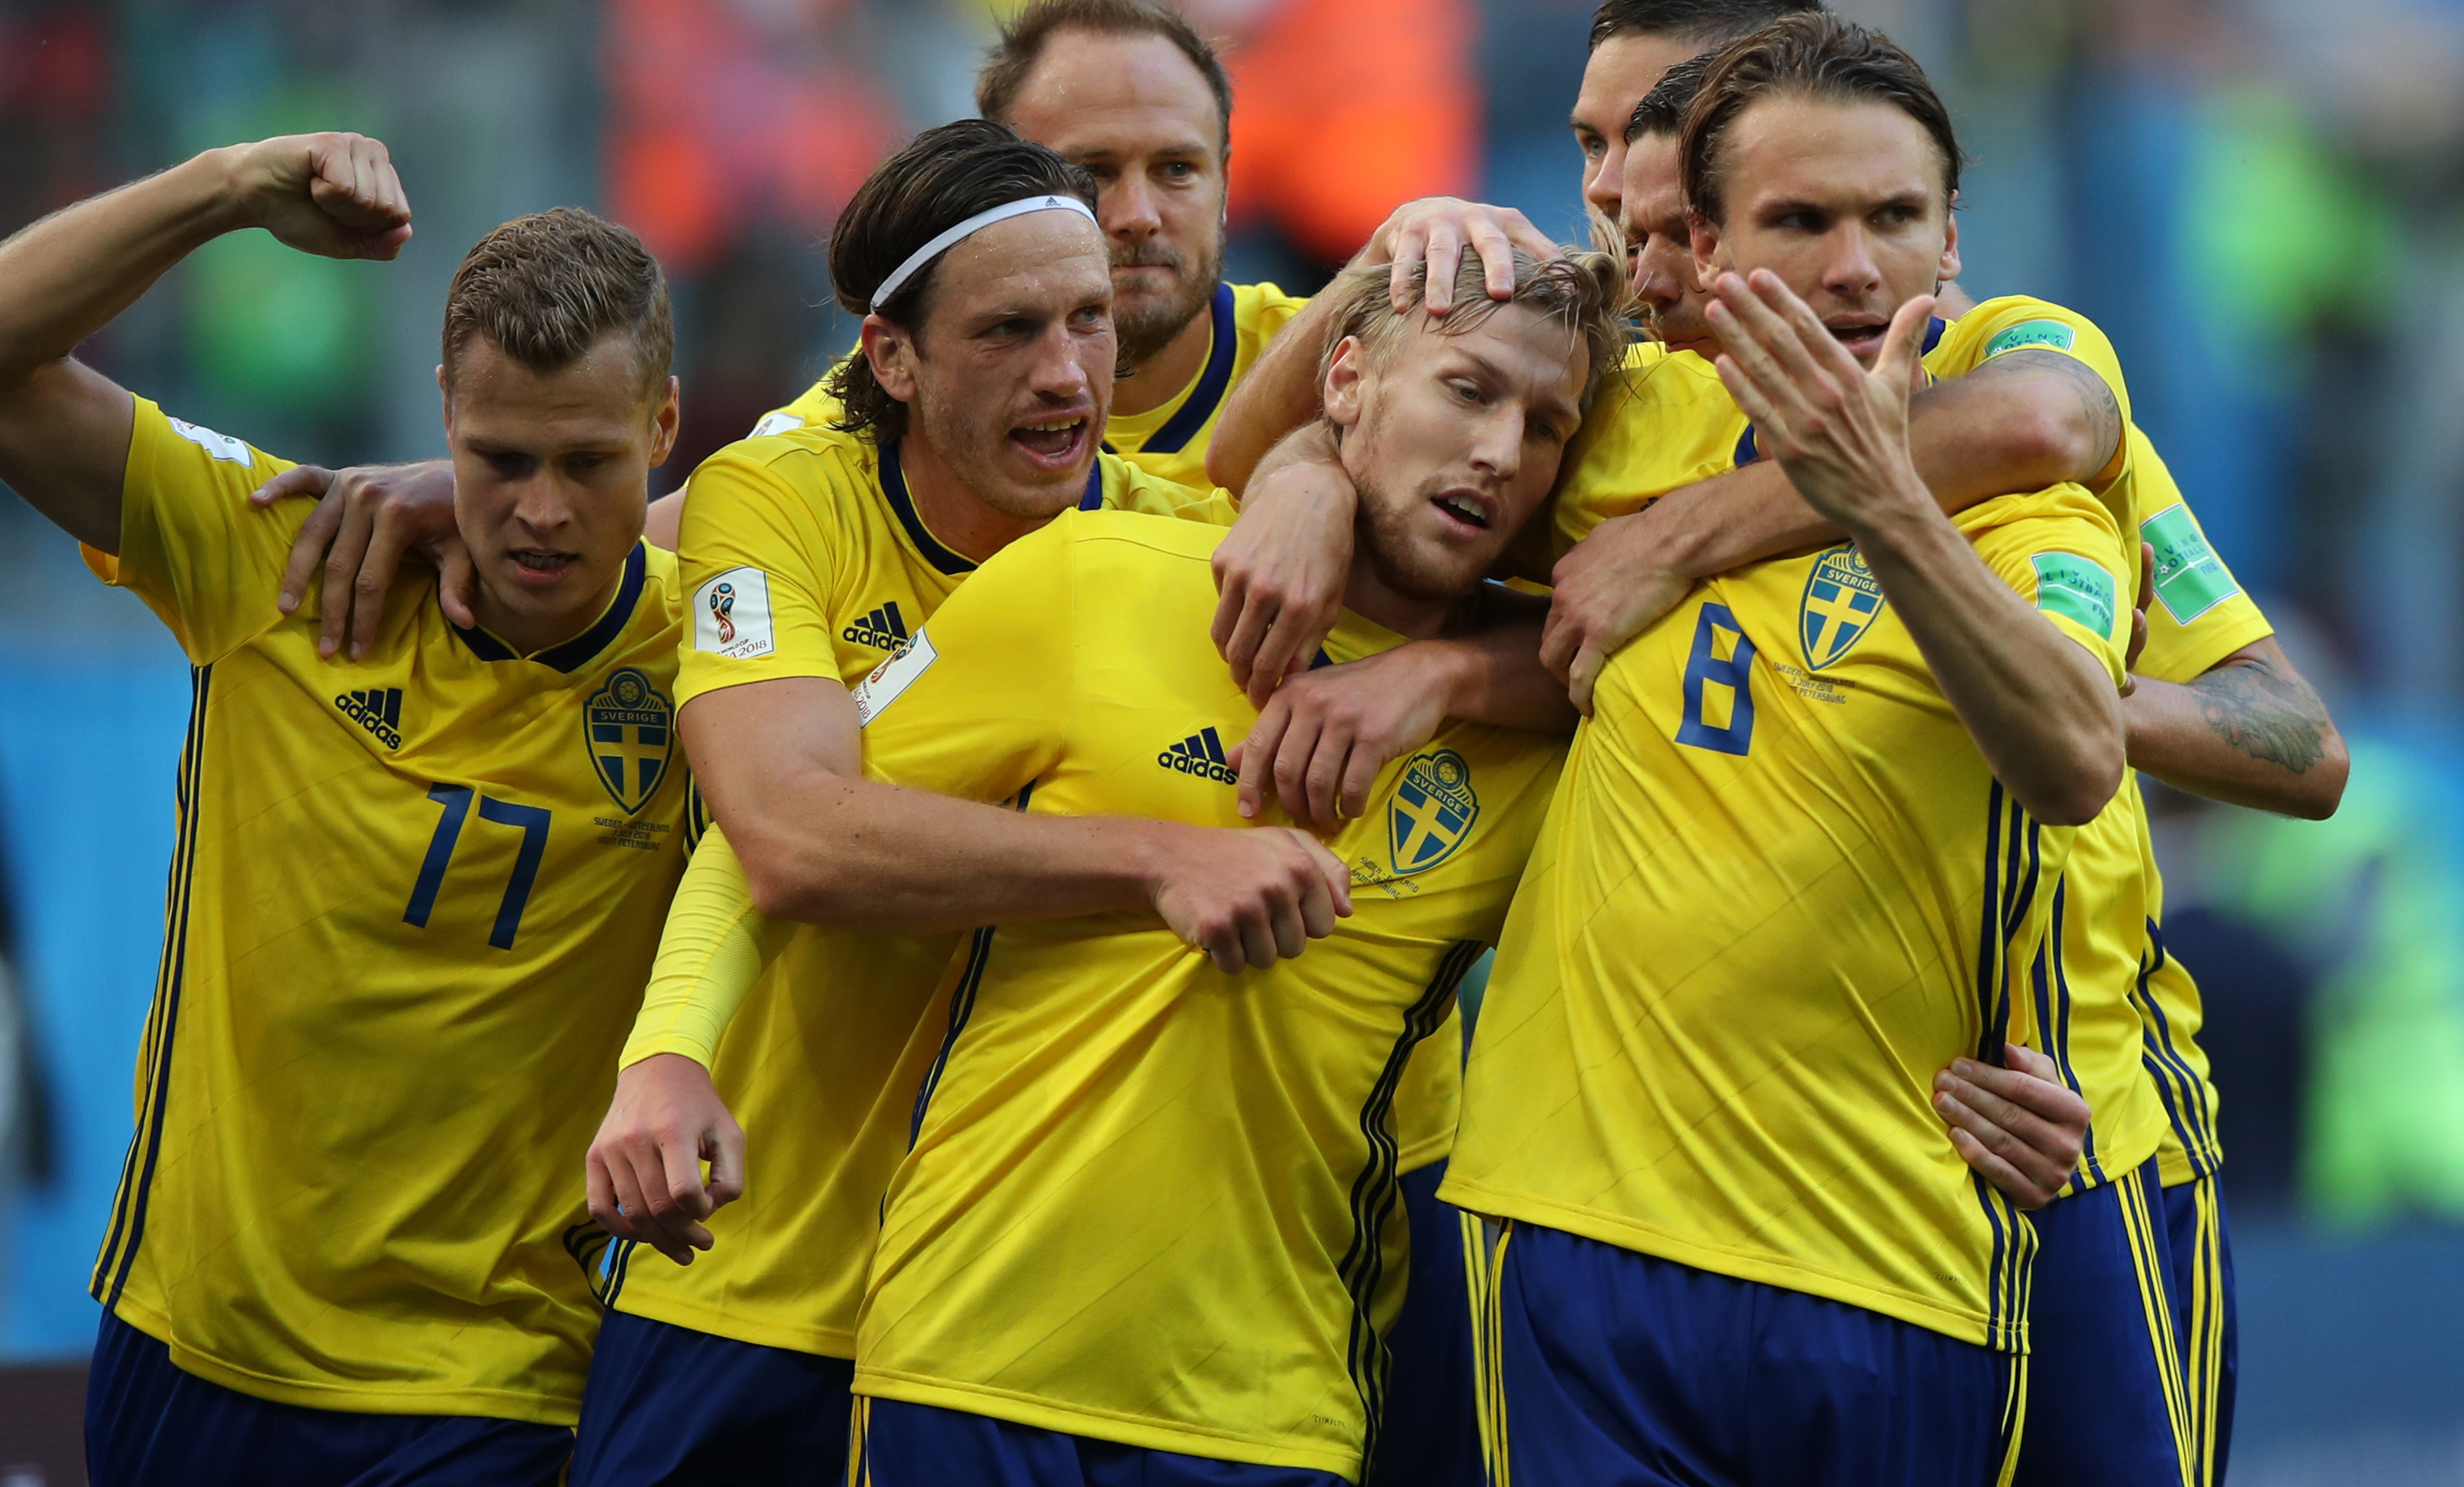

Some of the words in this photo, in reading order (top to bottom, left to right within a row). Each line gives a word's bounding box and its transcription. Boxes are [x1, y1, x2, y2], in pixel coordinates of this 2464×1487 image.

[2156, 534, 2198, 563] IVING
[1827, 569, 1878, 592] SVERIGE
[738, 639, 767, 657] 2018
[843, 627, 906, 652] adida
[1674, 602, 1758, 757] 8
[334, 694, 402, 750] adidas
[601, 711, 658, 723] SVERIGE
[856, 696, 872, 720] 2018
[1157, 751, 1237, 785] adidas
[1413, 774, 1463, 813] SVERIGE
[402, 781, 552, 951] 17
